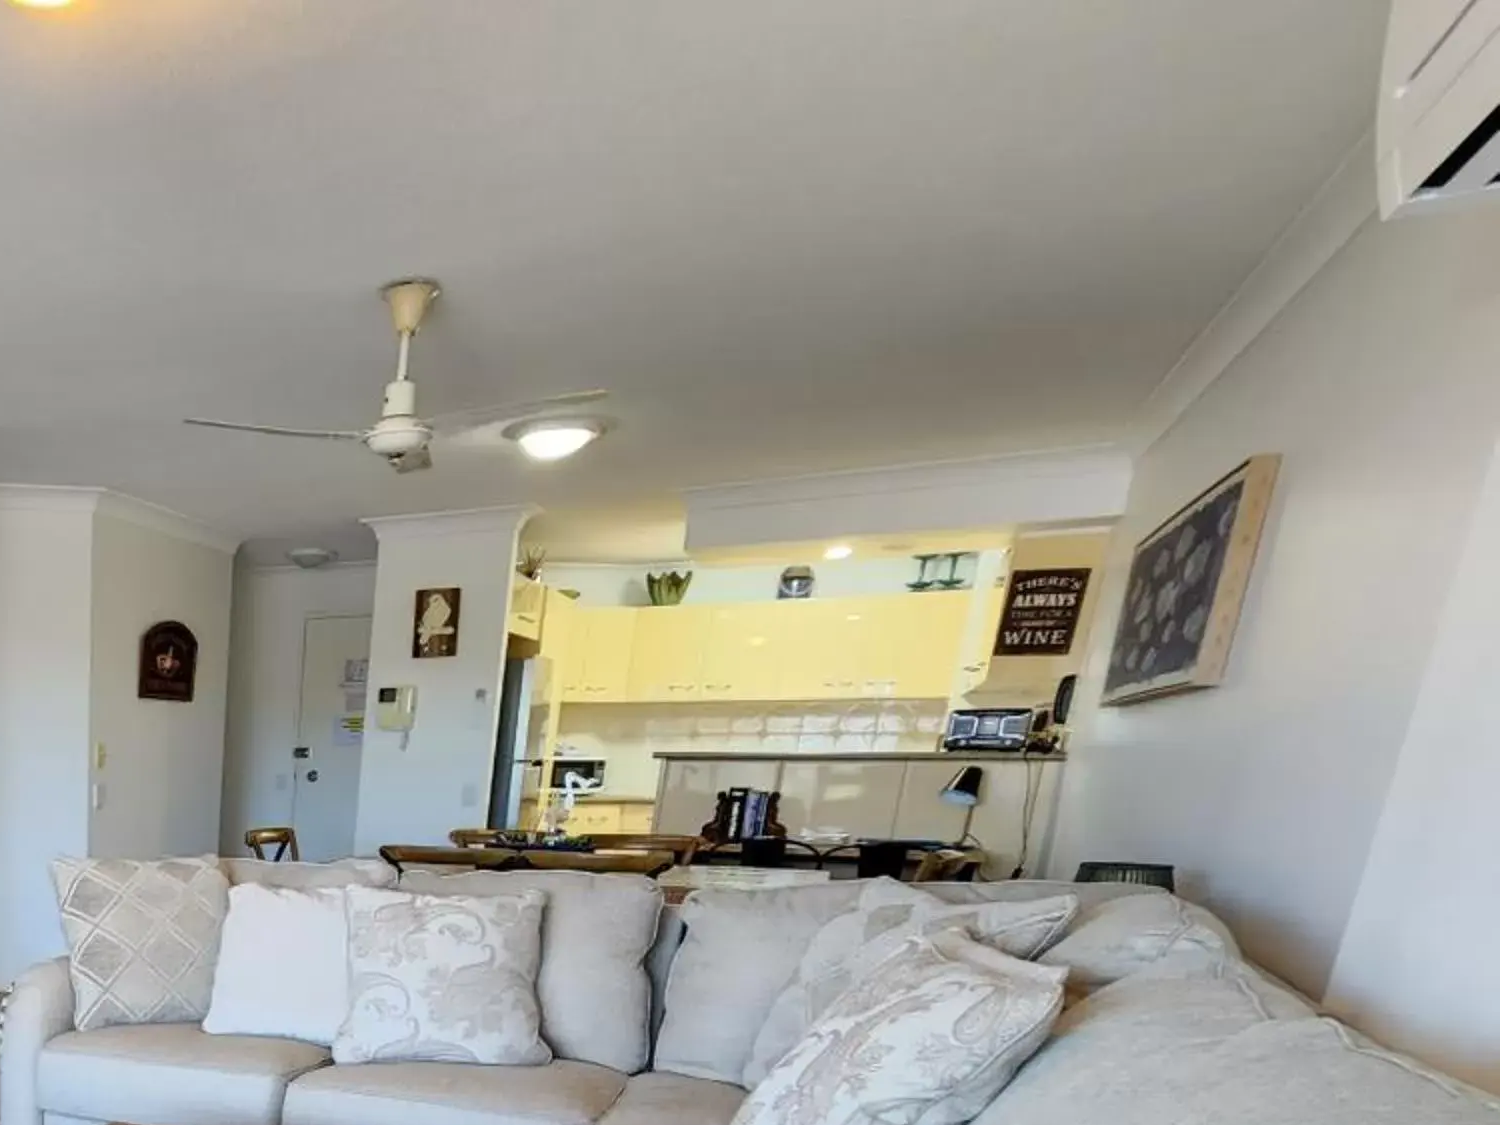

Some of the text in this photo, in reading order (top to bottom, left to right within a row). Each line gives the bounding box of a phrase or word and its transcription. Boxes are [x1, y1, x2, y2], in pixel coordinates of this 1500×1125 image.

[1015, 575, 1083, 591] THERE'S
[1011, 592, 1078, 608] ALWAYS
[1003, 628, 1068, 646] WINE
